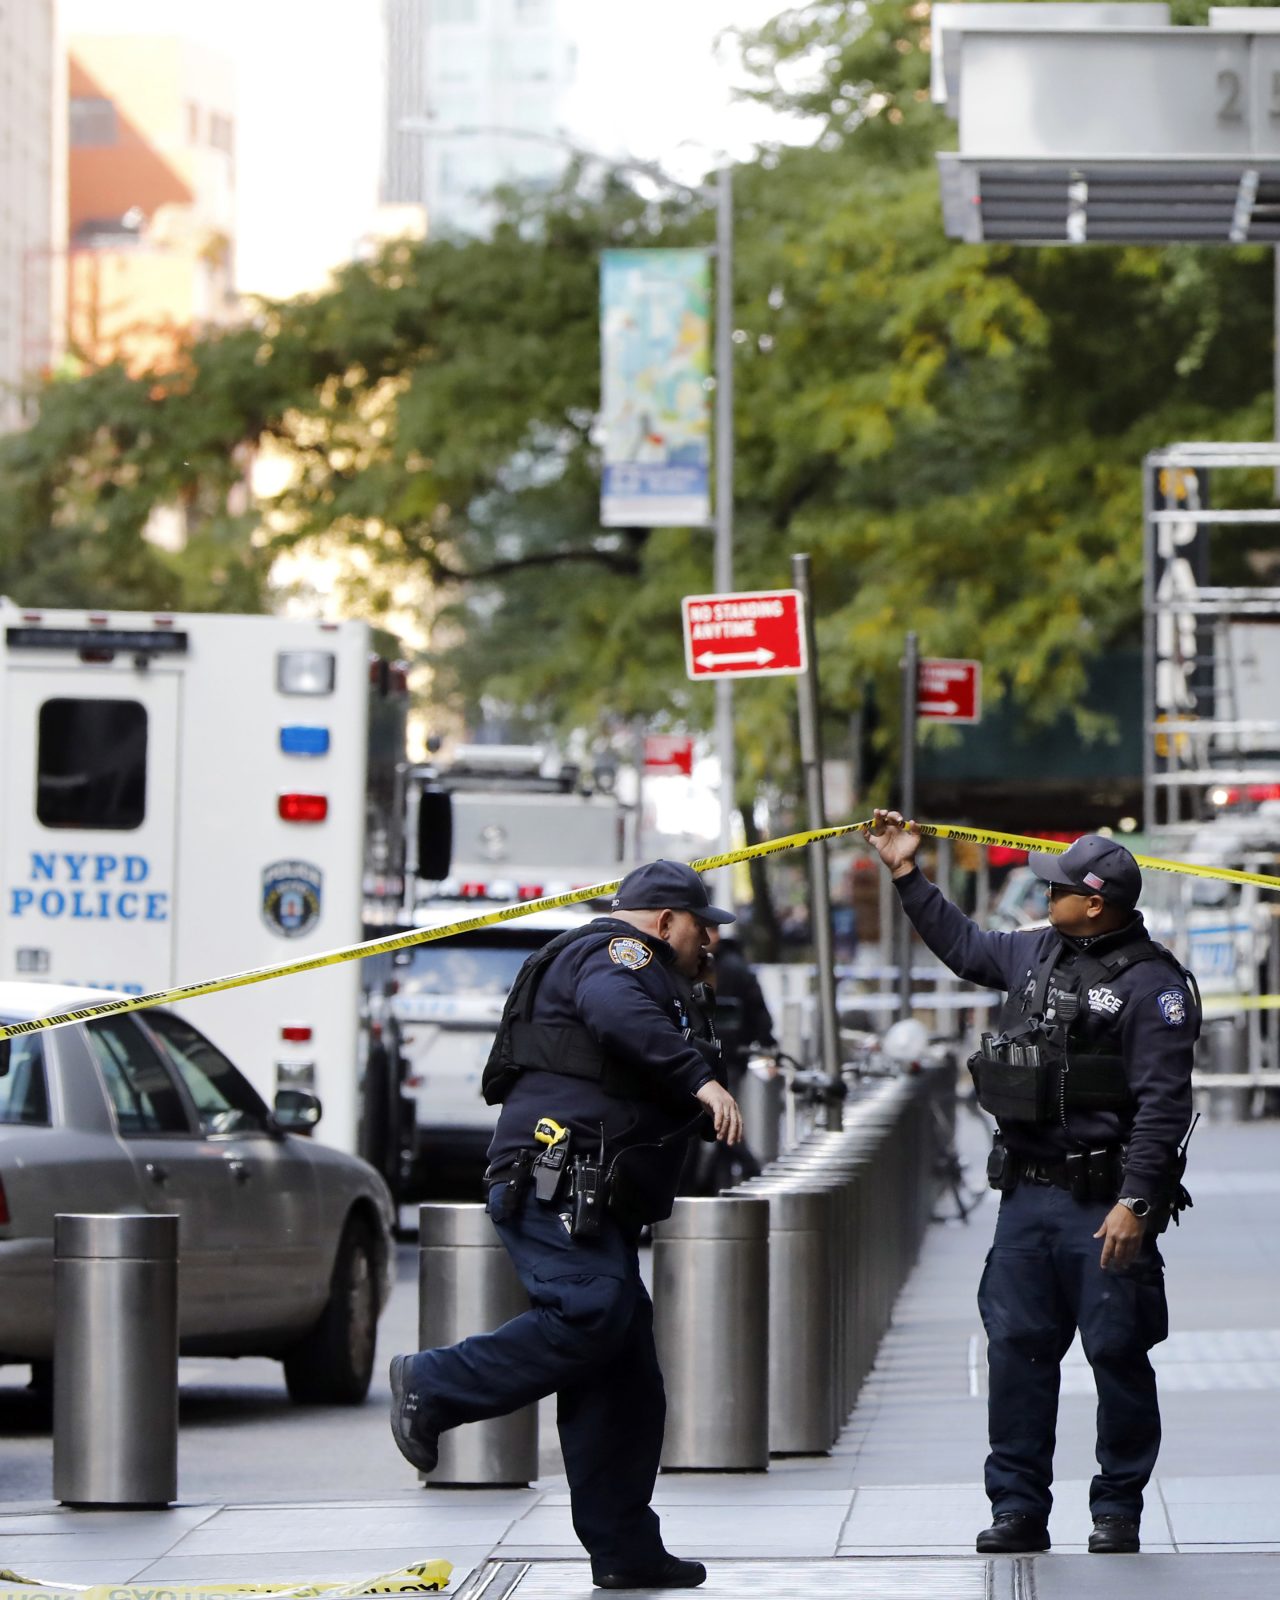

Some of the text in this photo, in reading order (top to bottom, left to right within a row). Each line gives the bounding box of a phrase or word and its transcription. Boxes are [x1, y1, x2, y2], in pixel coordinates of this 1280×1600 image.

[690, 600, 784, 622] NO STANDING
[692, 619, 757, 640] ANYTIME
[31, 852, 149, 882] NYPD
[10, 888, 168, 921] POLICE
